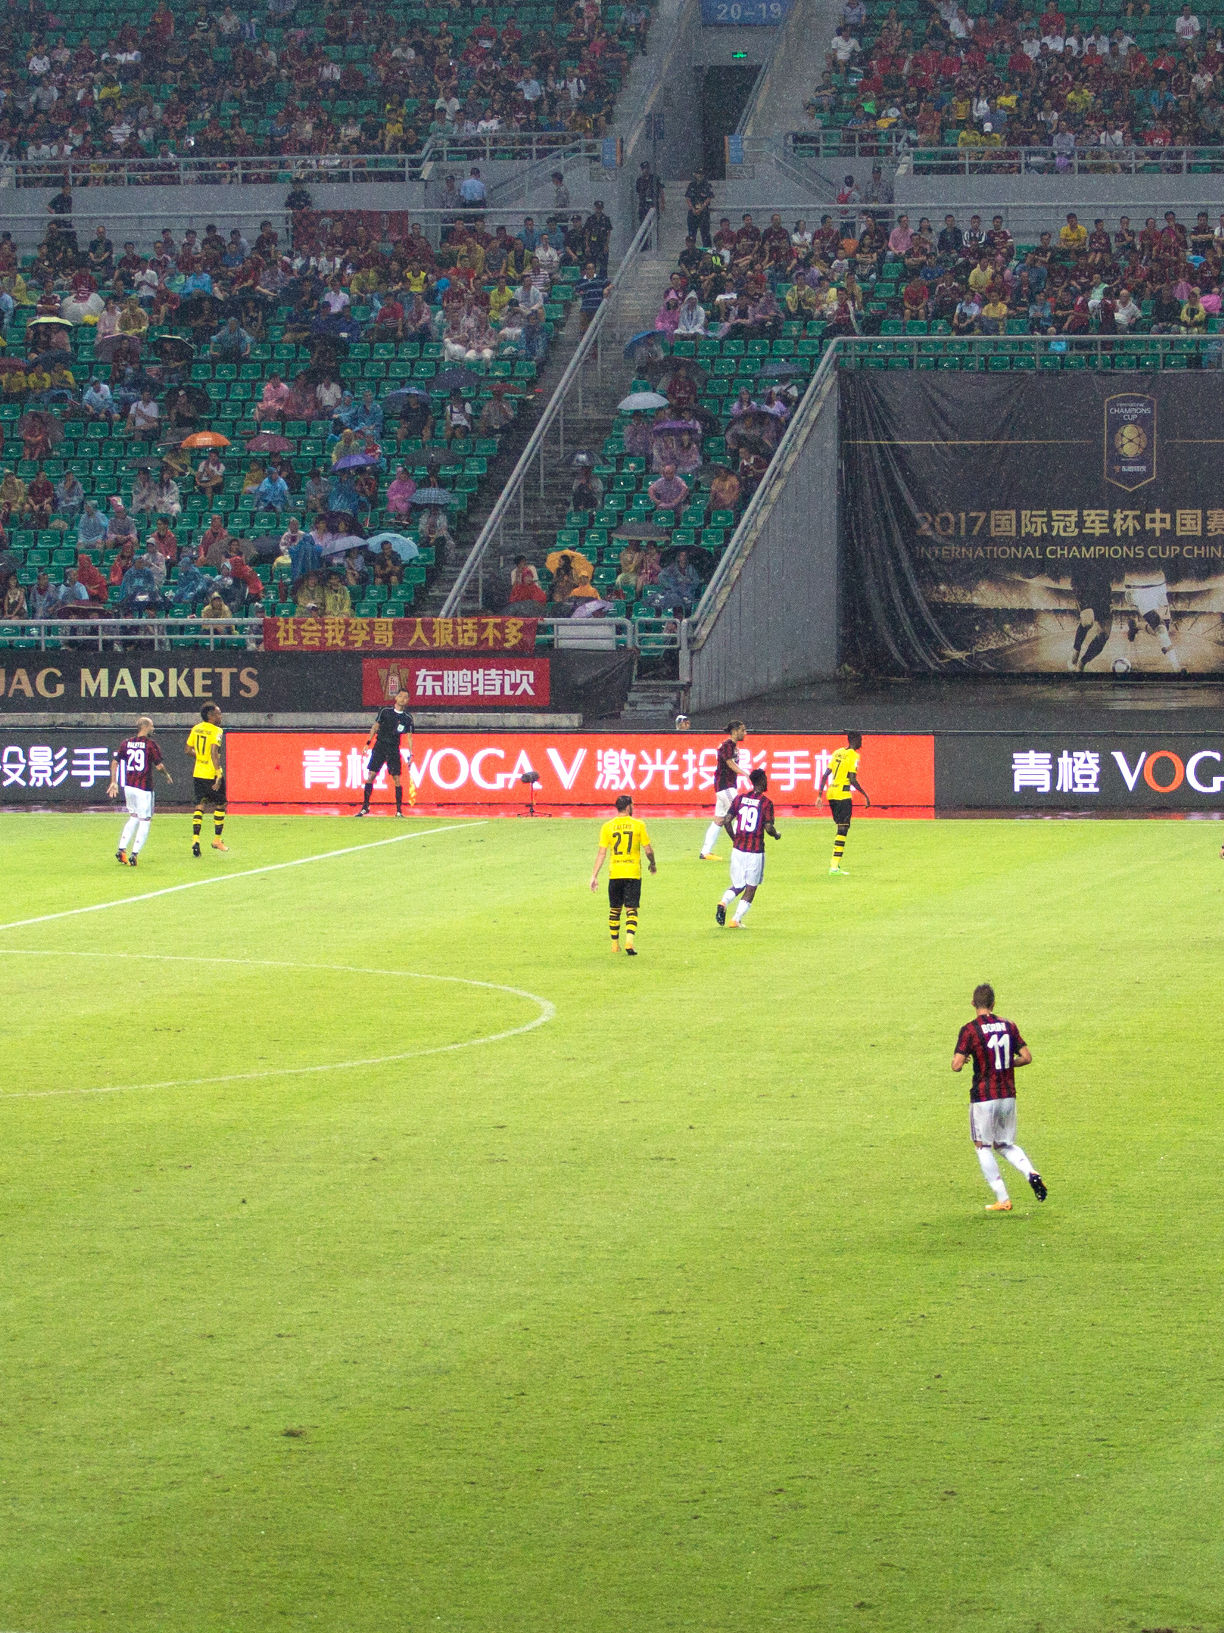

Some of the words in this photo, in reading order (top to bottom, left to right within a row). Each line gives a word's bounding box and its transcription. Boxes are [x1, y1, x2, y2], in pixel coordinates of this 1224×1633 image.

[915, 546, 1042, 558] INTERNATIONAL
[1045, 546, 1144, 558] CHAMPIONS
[1147, 545, 1180, 558] CUP
[0, 667, 65, 697] AG
[80, 667, 260, 698] MARKETS
[415, 668, 535, 696] 东鹏特饮
[197, 735, 206, 755] 17
[126, 748, 145, 772] 29
[546, 748, 588, 790] V
[1011, 750, 1100, 792] 青橙
[738, 806, 758, 832] 19
[612, 831, 633, 855] 27
[987, 1033, 1010, 1070] 11
